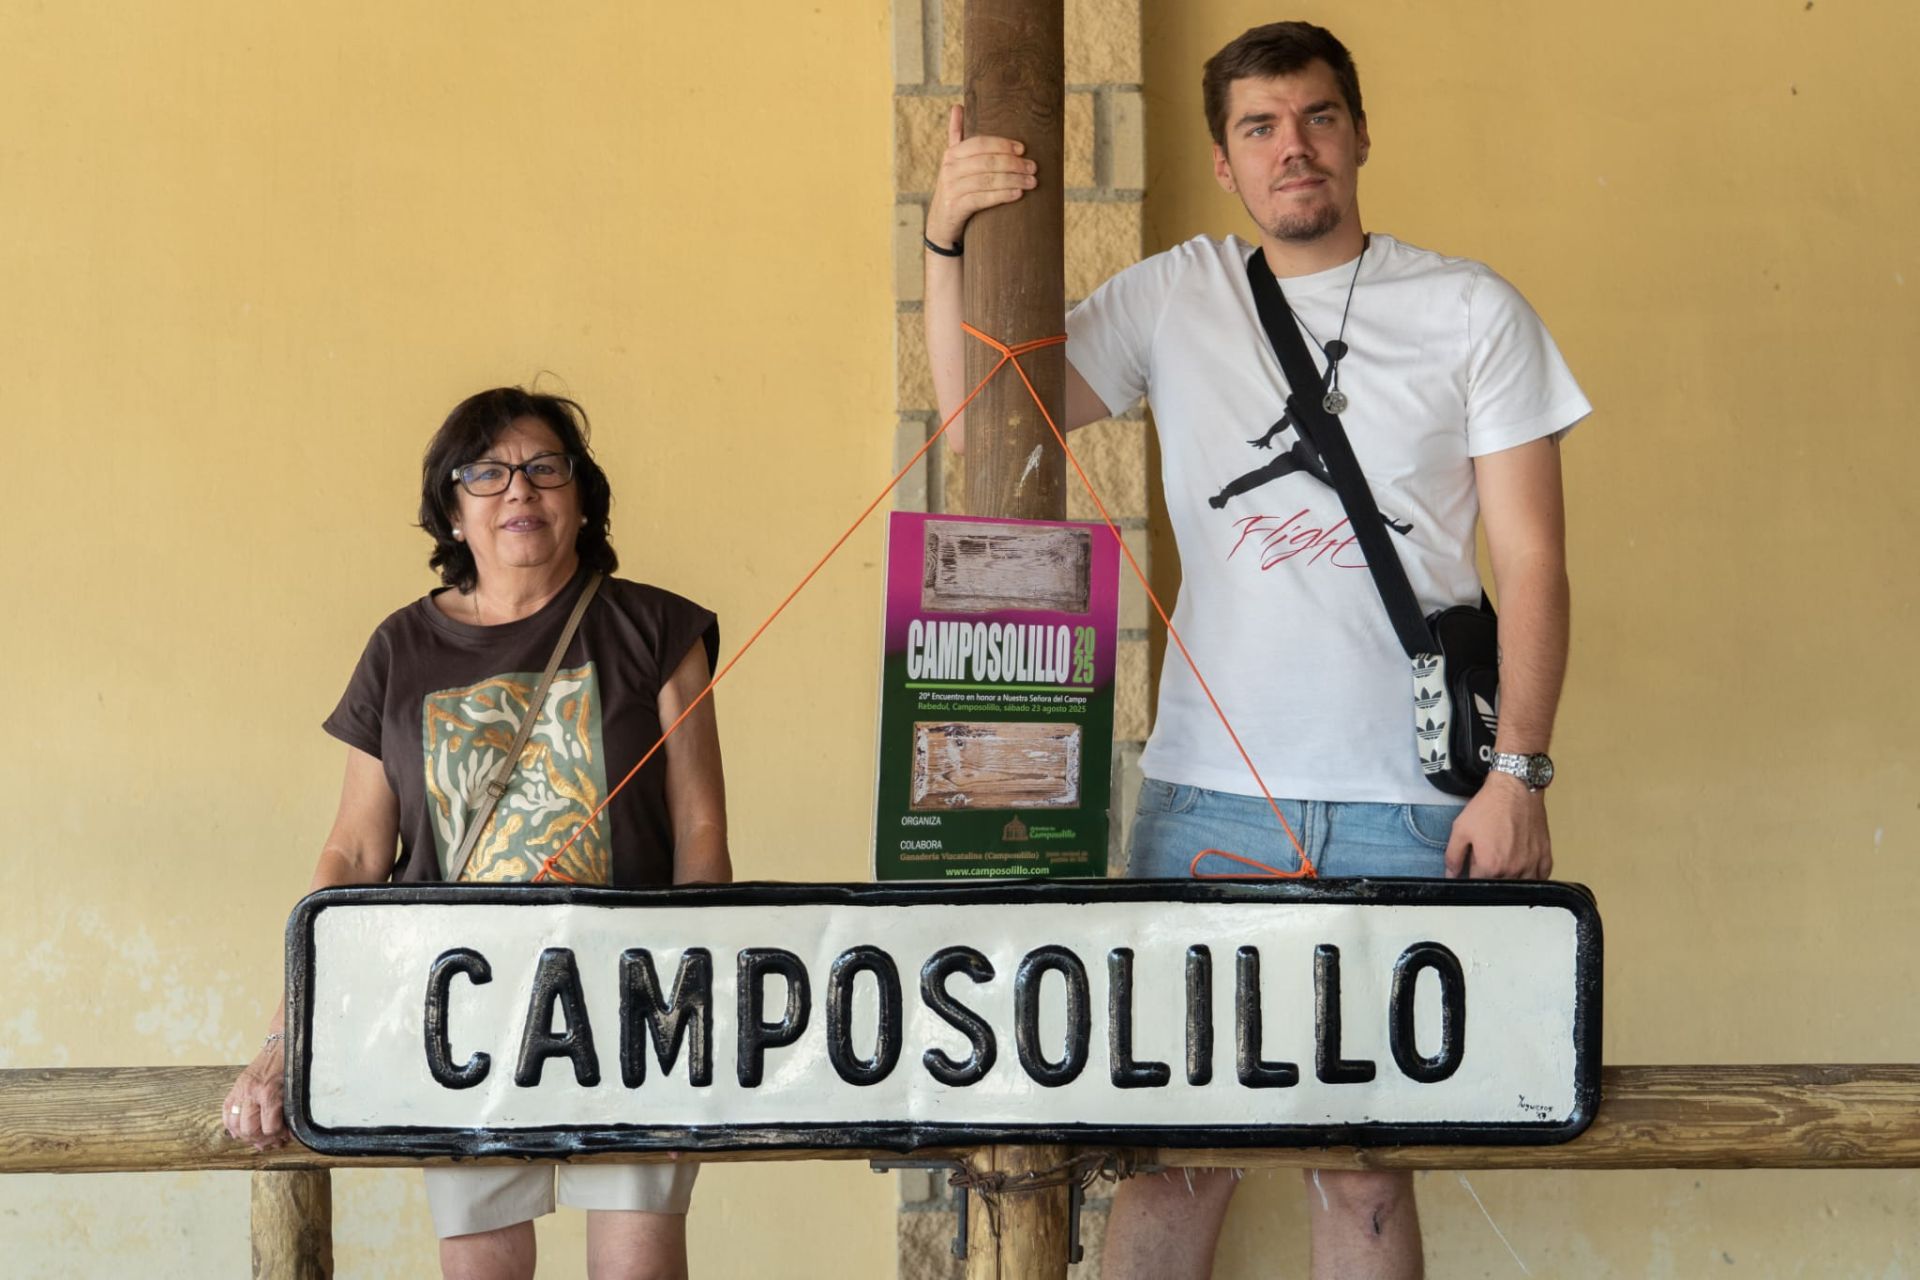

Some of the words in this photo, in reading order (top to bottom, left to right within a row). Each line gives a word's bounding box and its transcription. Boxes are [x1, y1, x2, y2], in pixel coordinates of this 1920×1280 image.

[1227, 508, 1371, 571] Flight
[1073, 626, 1096, 656] 20
[907, 619, 1071, 684] CAMPOSOLILLO
[1072, 655, 1095, 683] 25
[931, 692, 965, 701] Encuentro
[976, 692, 996, 701] honor
[1003, 694, 1028, 702] Nuestra
[1029, 694, 1052, 703] Señora
[1053, 695, 1063, 703] del
[1064, 695, 1087, 704] Campo
[952, 703, 1002, 712] Camposolillo,
[1003, 704, 1030, 712] sábado
[1031, 704, 1041, 712] 23
[1042, 705, 1067, 714] agosto
[1068, 705, 1087, 713] 2025
[901, 816, 942, 826] ORGANIZA
[900, 840, 943, 850] COLABORA
[945, 866, 1050, 878] www.camposolillo.com
[424, 941, 1465, 1089] CAMPOSOLILLO
